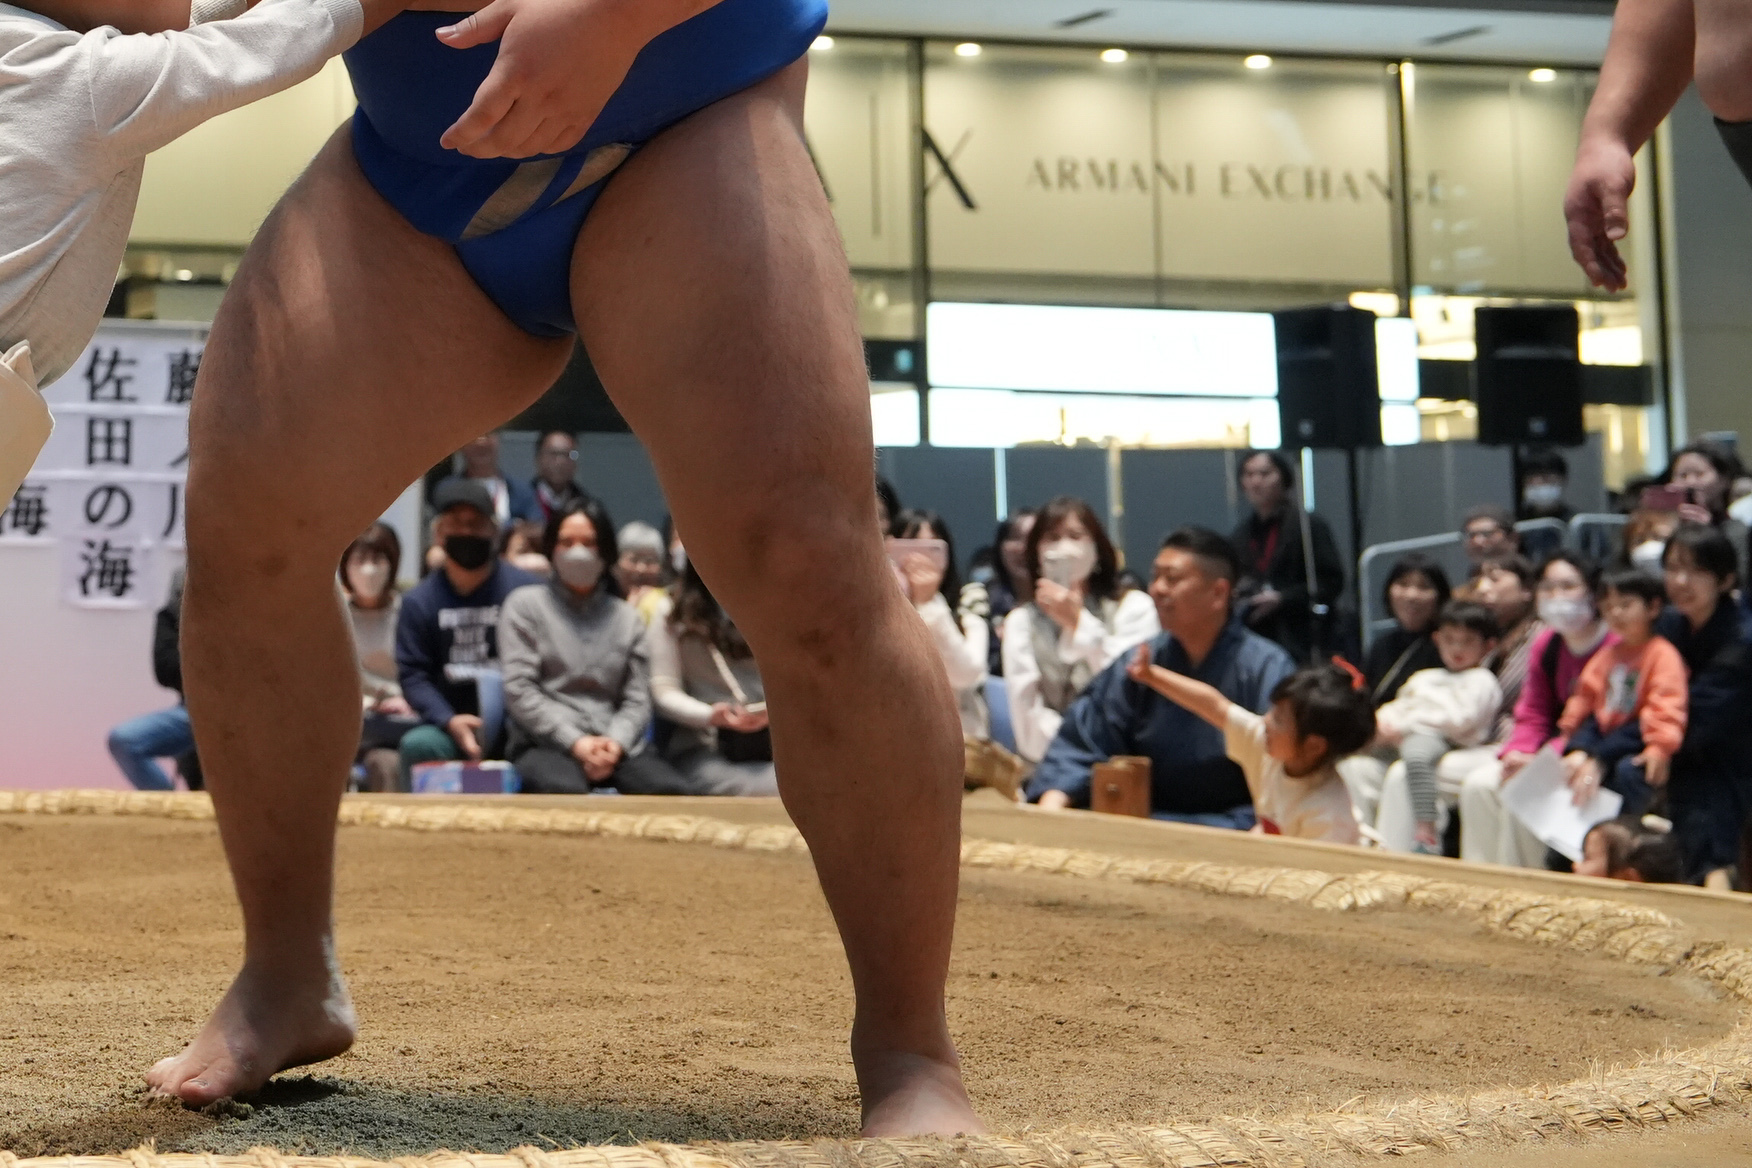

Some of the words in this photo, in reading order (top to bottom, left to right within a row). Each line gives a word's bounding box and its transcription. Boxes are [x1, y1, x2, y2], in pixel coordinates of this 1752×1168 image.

[1027, 153, 1197, 198] ARMANI
[77, 345, 139, 598] 佐田の海
